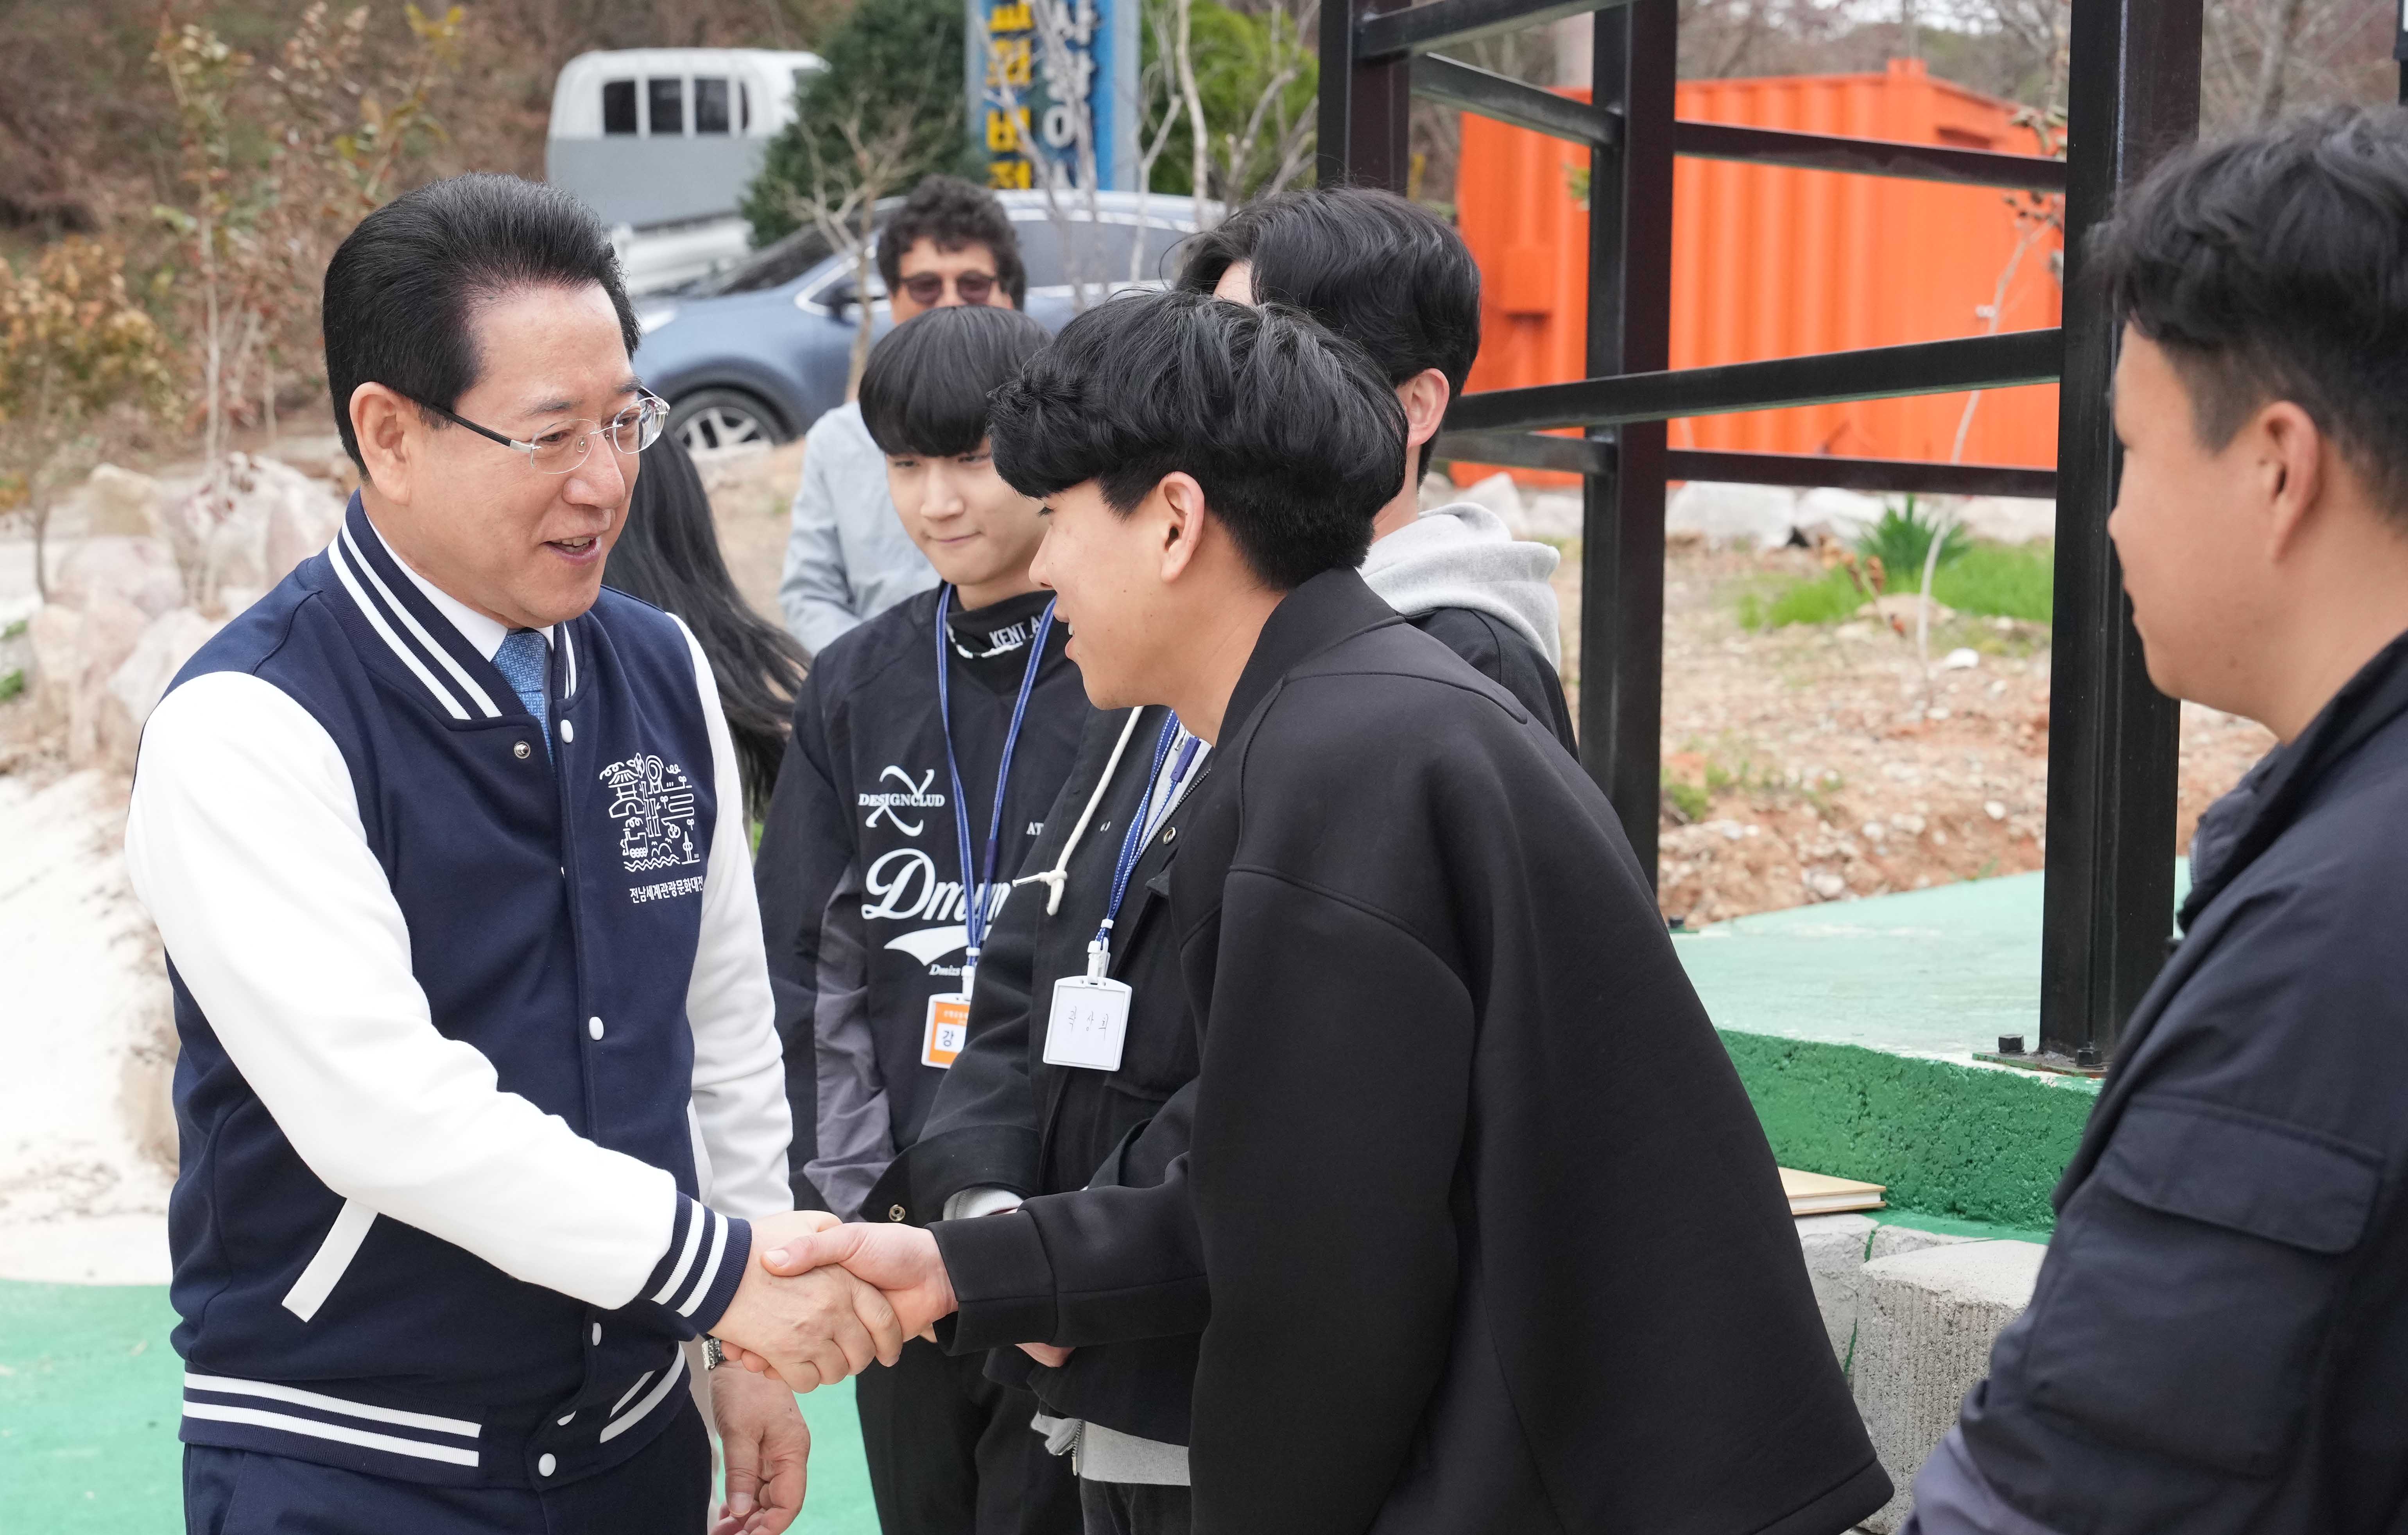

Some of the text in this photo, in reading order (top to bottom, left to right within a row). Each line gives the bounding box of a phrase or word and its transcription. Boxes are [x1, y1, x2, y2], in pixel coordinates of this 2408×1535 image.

[989, 622, 1026, 649] KENT
[858, 793, 945, 807] DESIGNCLUD
[629, 875, 703, 903] 전남세계관광문화대전
[942, 1030, 954, 1047] 강
